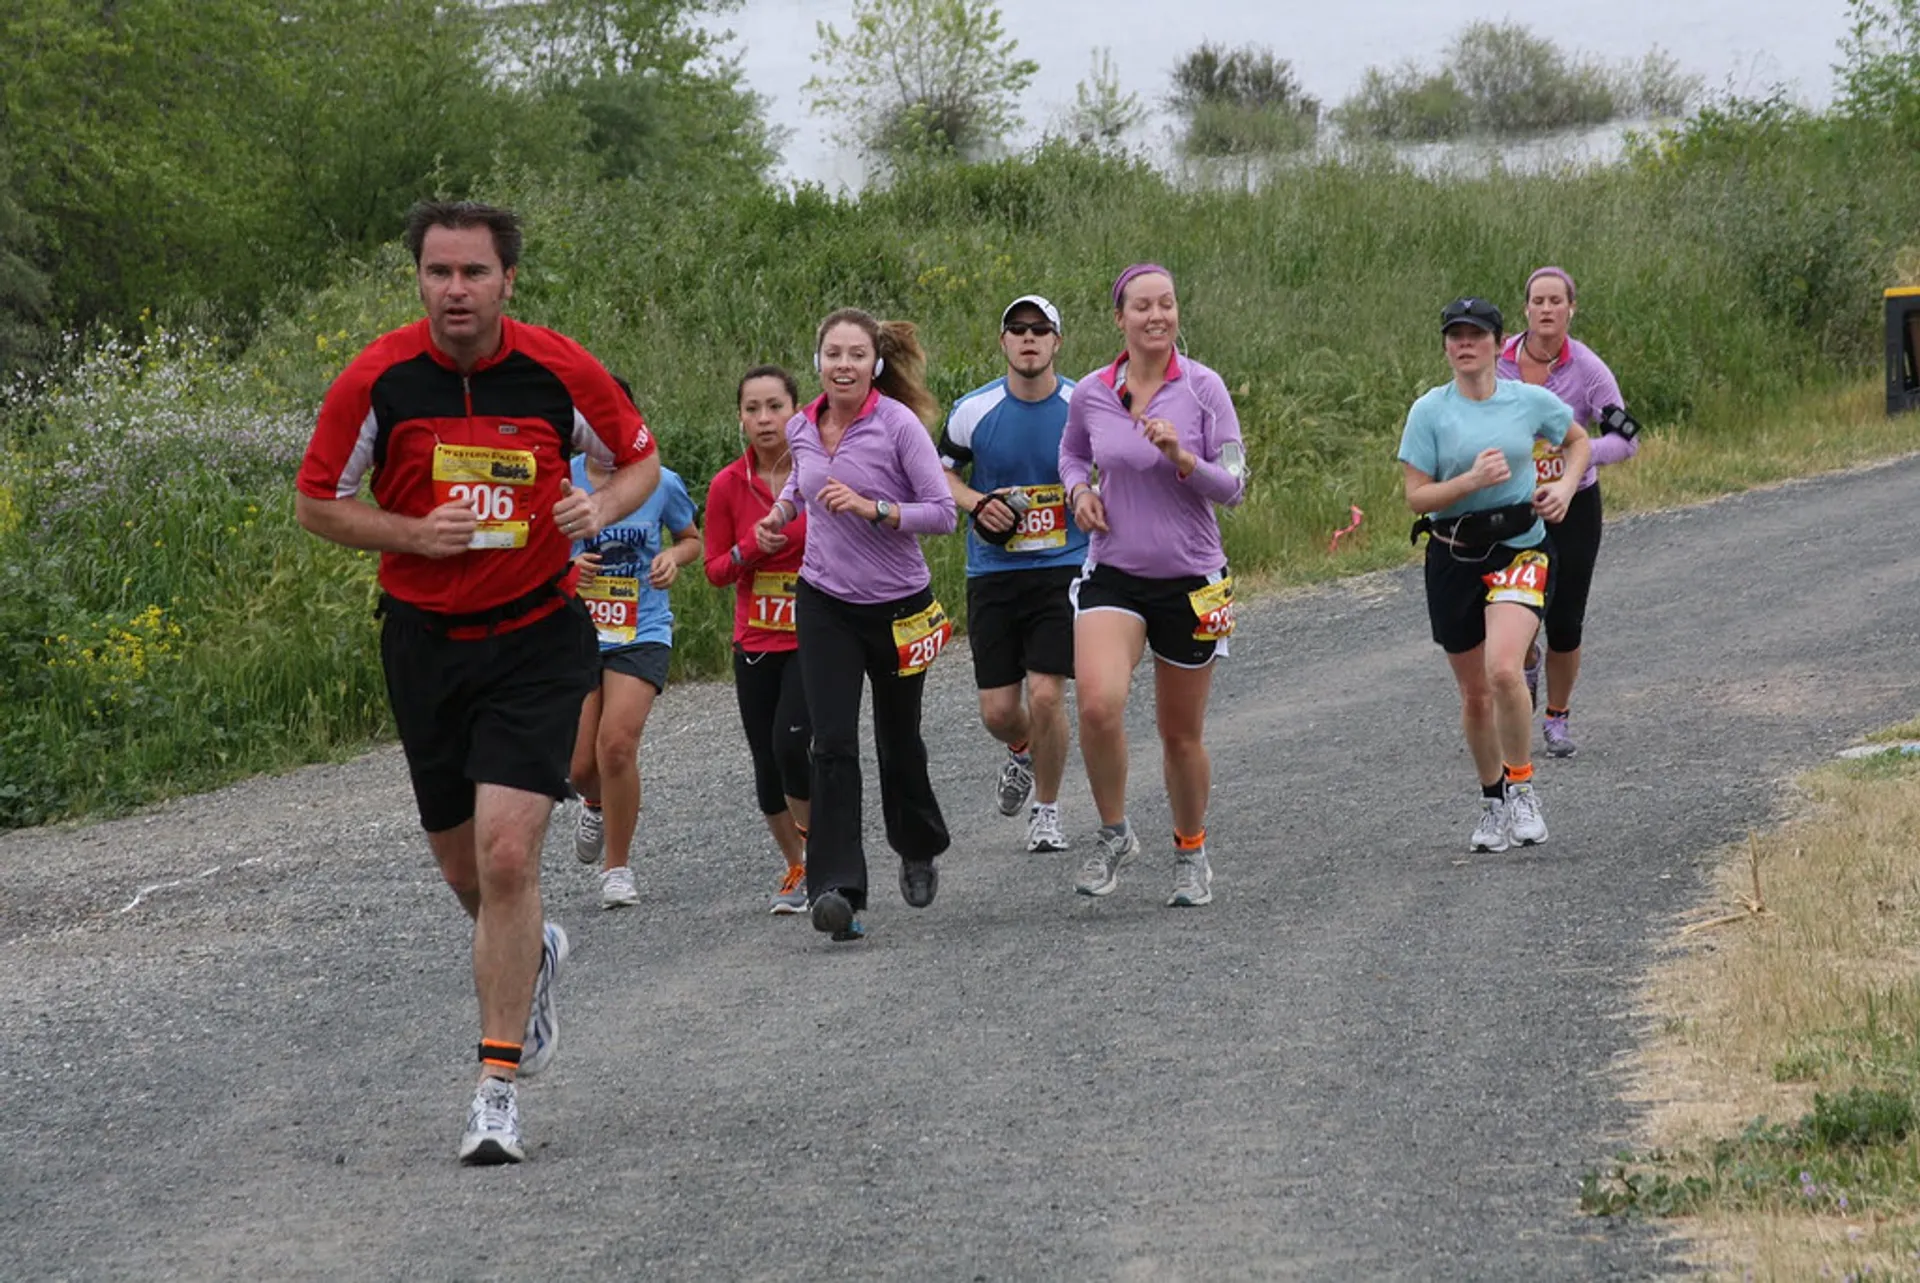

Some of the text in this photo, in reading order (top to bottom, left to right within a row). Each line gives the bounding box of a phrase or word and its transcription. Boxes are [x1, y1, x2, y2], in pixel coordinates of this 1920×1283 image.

[1535, 457, 1565, 481] 30
[448, 484, 515, 520] 206
[584, 600, 627, 626] 299
[755, 597, 796, 624] 171
[908, 628, 944, 667] 287
